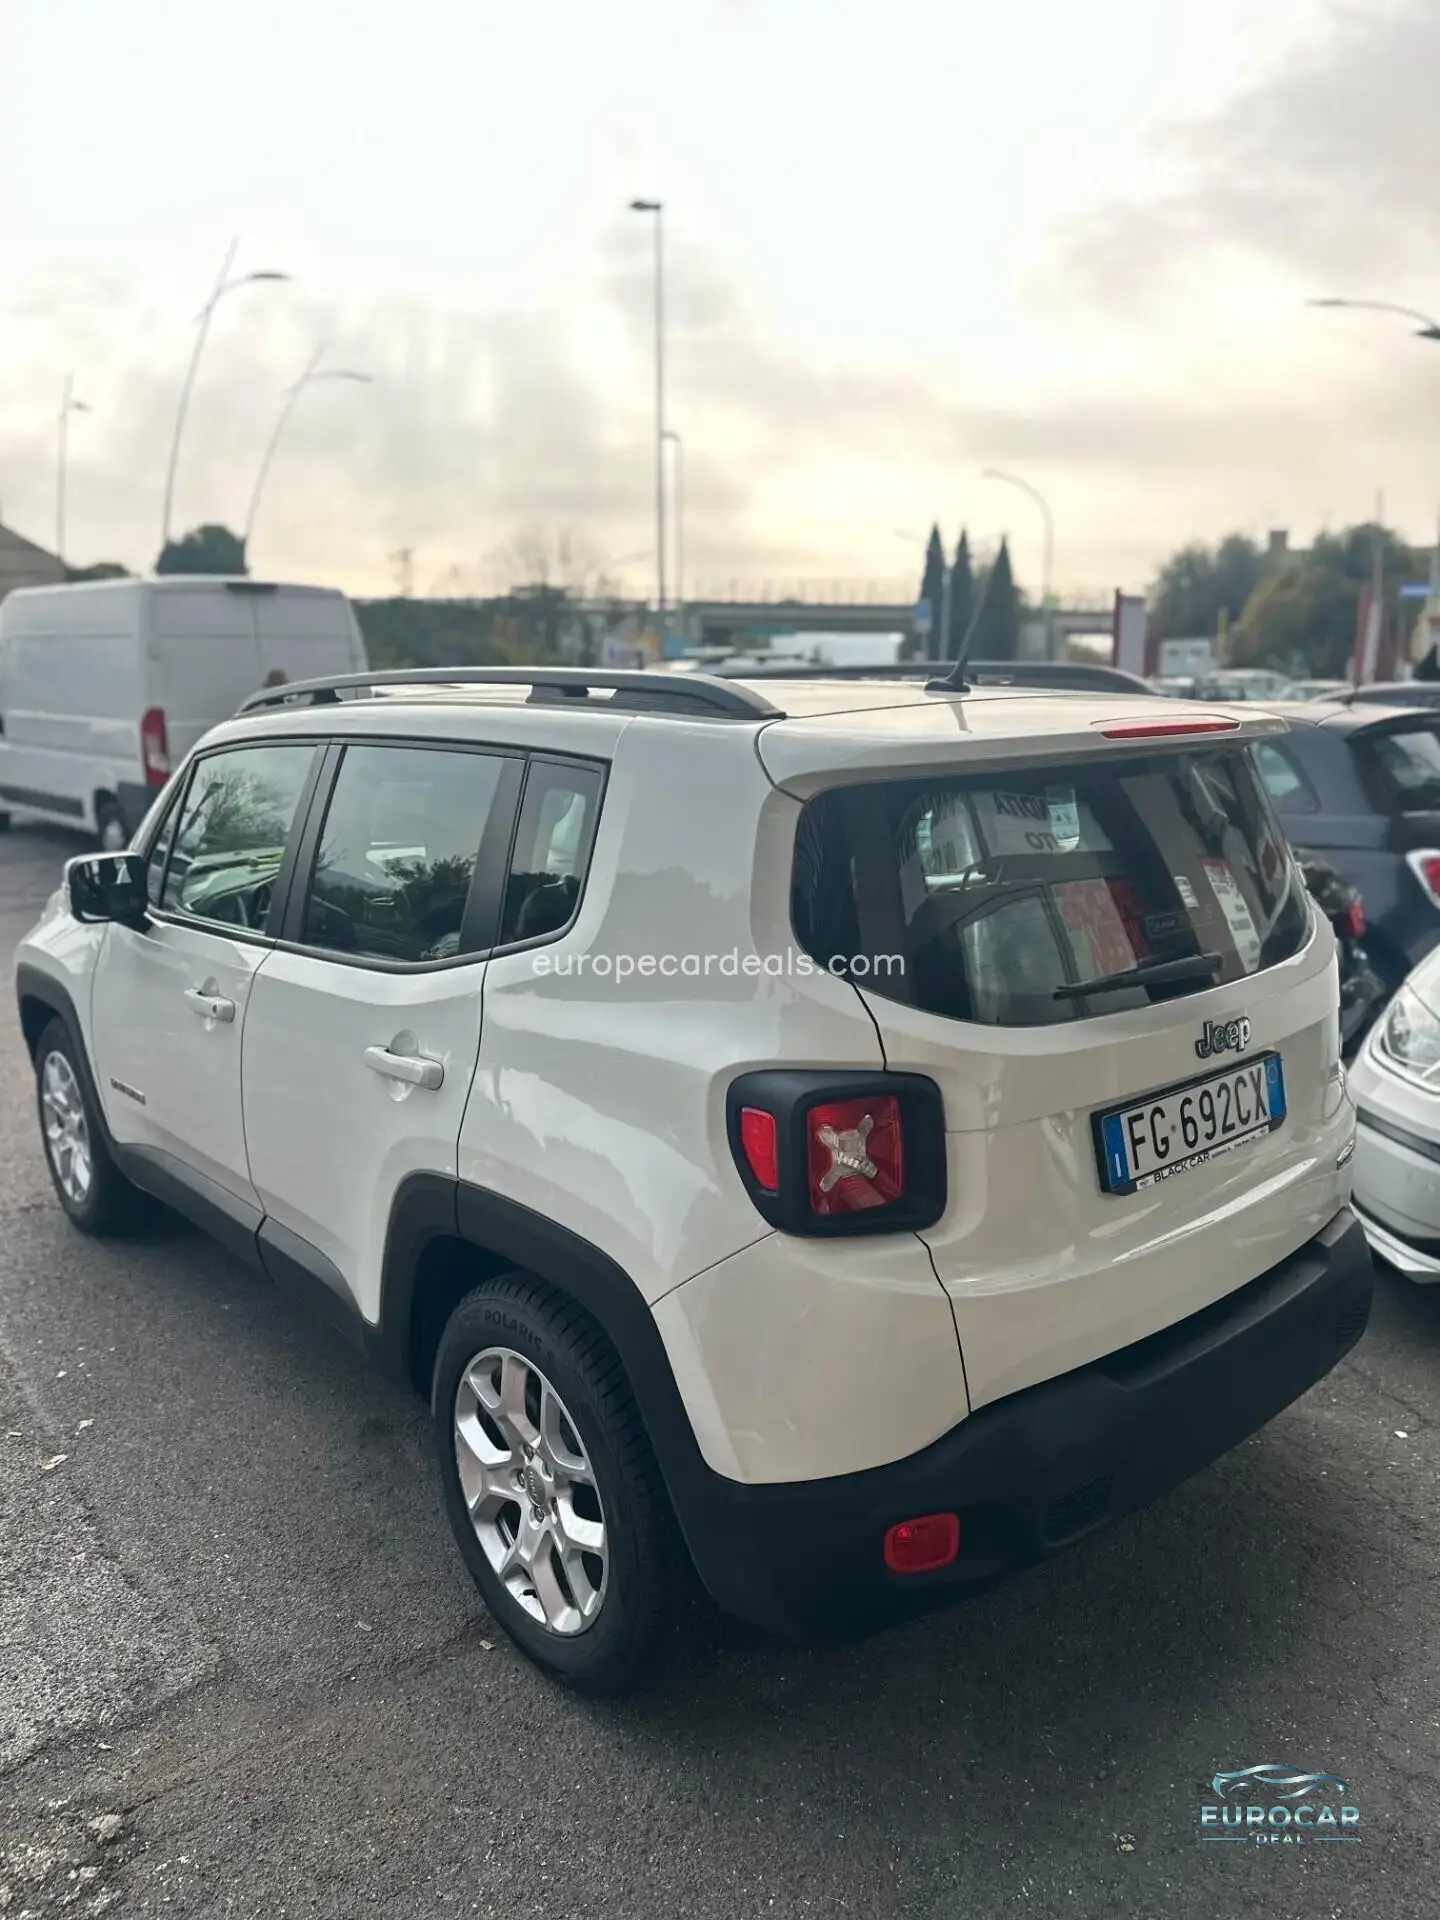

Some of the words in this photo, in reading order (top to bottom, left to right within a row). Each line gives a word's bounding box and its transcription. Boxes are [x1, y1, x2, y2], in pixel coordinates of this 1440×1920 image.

[1195, 1016, 1251, 1059] Jeep
[1153, 1161, 1189, 1183] BLACK
[1189, 1152, 1211, 1168] CAR
[484, 1309, 543, 1351] POLARIS
